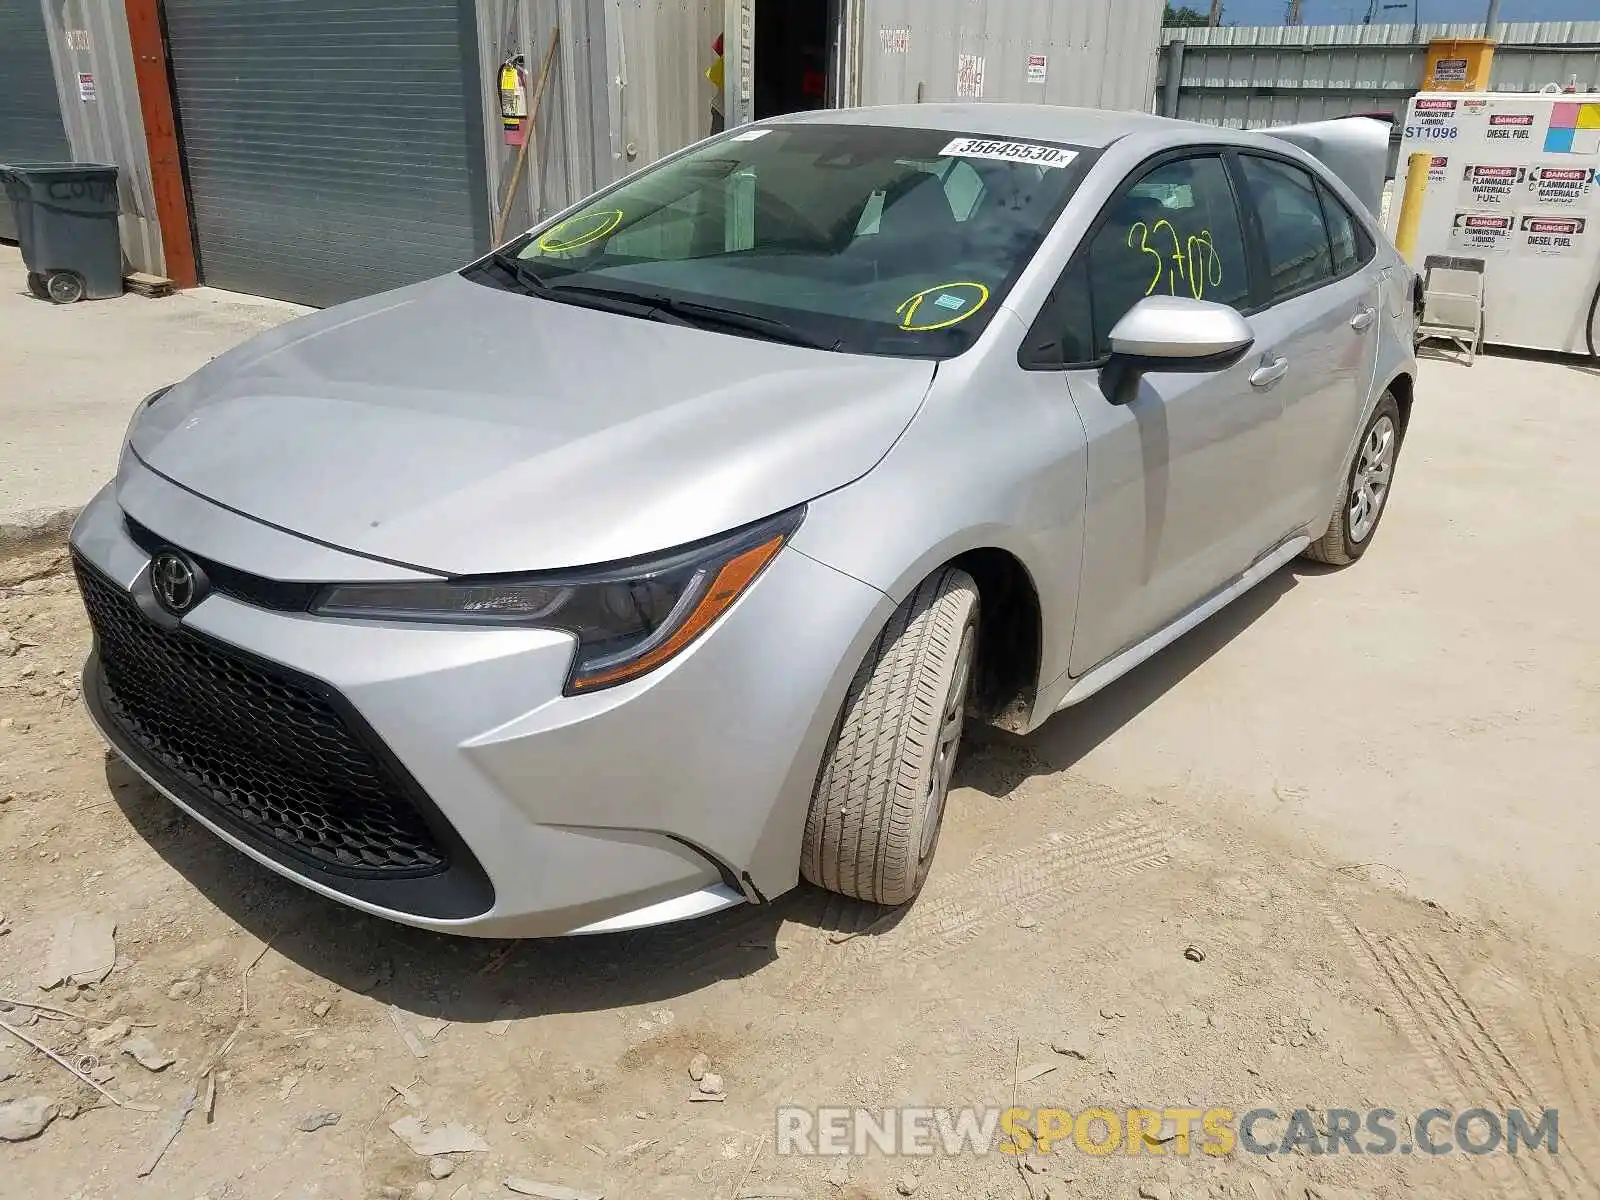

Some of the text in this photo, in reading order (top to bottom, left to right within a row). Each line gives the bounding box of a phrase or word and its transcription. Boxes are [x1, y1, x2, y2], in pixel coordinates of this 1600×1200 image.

[1420, 100, 1452, 108] DANGER
[1405, 127, 1457, 138] ST1098
[1487, 129, 1530, 139] DIESEL FUEL
[1479, 168, 1512, 176] DANGER
[1545, 171, 1581, 179] DANGER
[1472, 177, 1515, 186] FLAMMABLE
[1538, 181, 1584, 190] FLAMMABLE
[1472, 185, 1512, 194] MATERIALS
[1539, 190, 1580, 198] MATERIALS
[1471, 219, 1503, 227] DANGER
[1464, 228, 1507, 237] COMBUSTIBLE
[1535, 224, 1570, 232] DANGER
[1527, 236, 1572, 246] DIESEL FUEL
